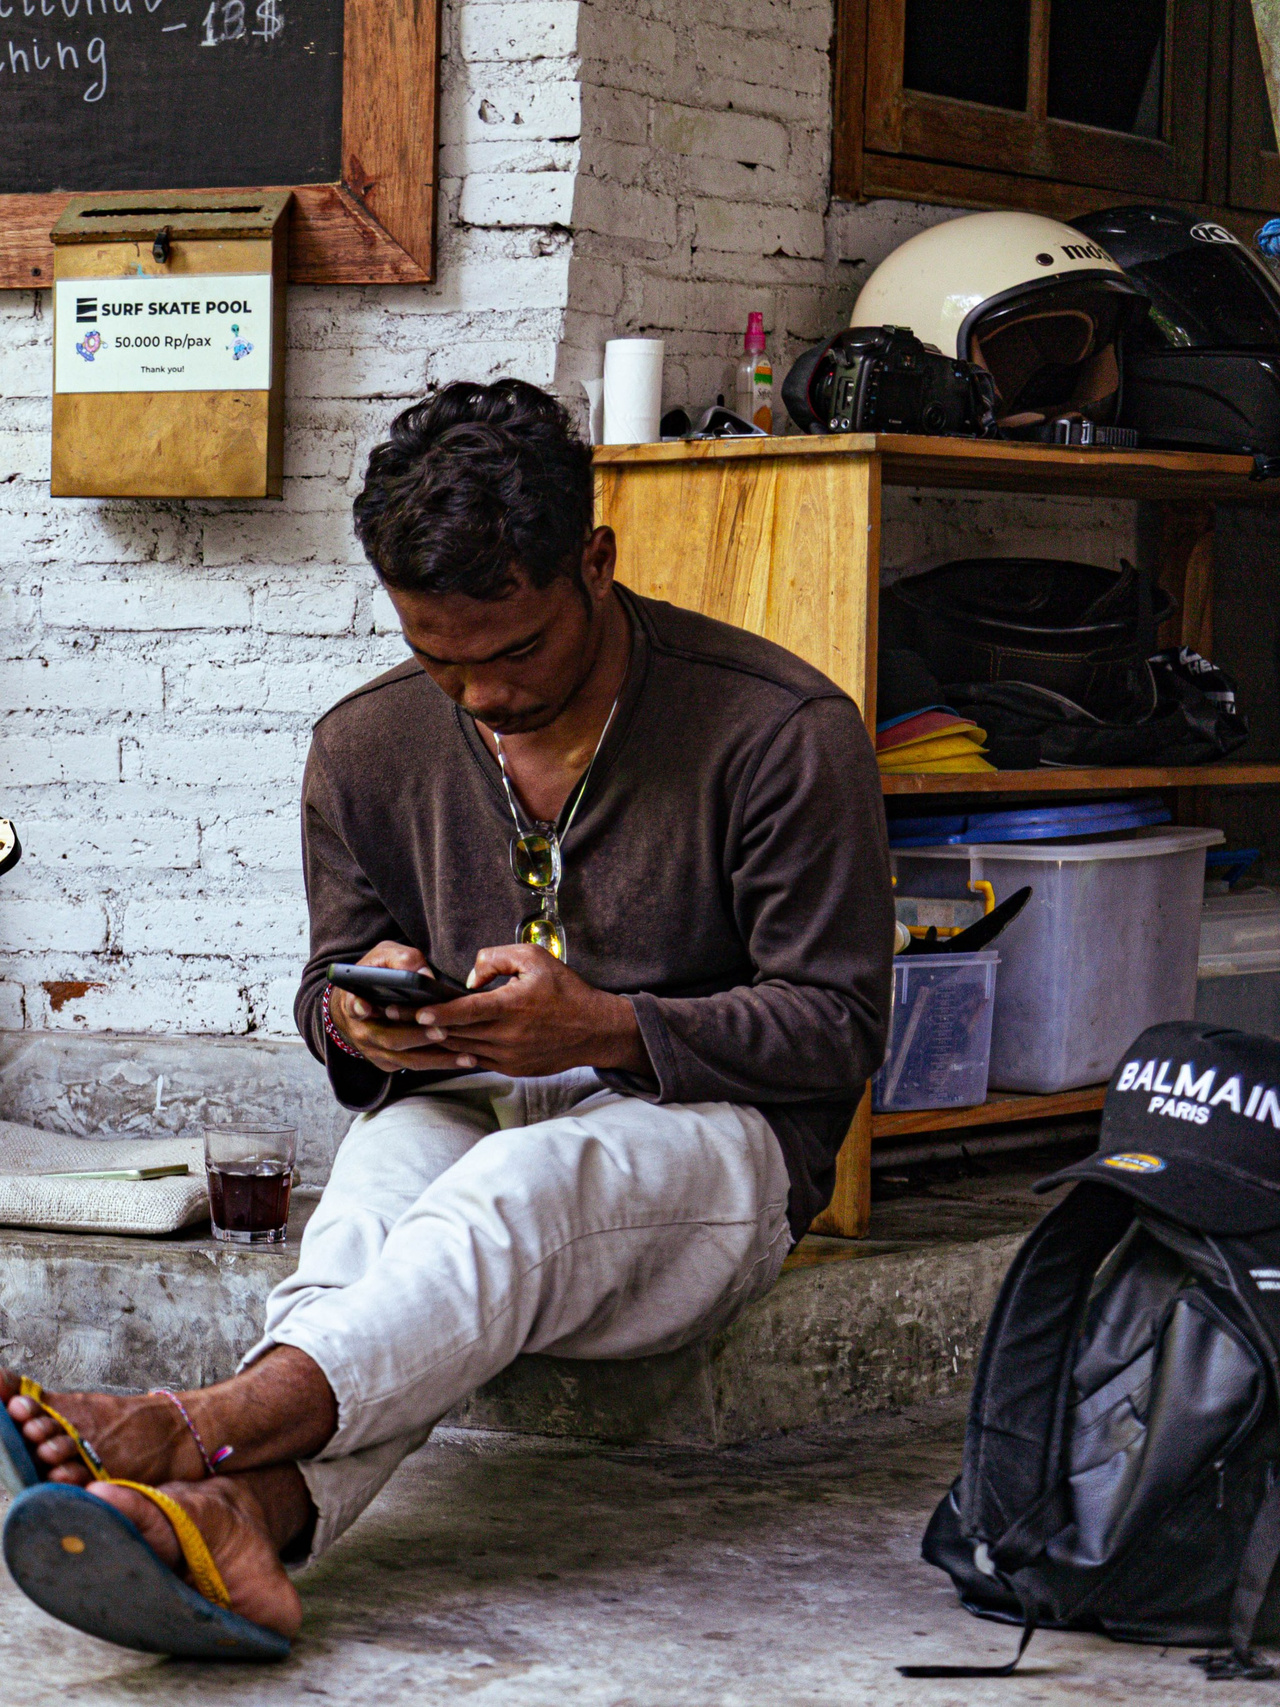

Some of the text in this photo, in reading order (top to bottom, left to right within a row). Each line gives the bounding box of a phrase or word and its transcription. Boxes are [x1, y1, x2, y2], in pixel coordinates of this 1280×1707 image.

[101, 300, 252, 316] SURF SKATE POOL
[115, 333, 212, 350] 50.000 Rp/pax
[140, 365, 185, 375] Thank you!
[1116, 1059, 1280, 1130] BALMAIN
[1147, 1096, 1211, 1126] PARIS
